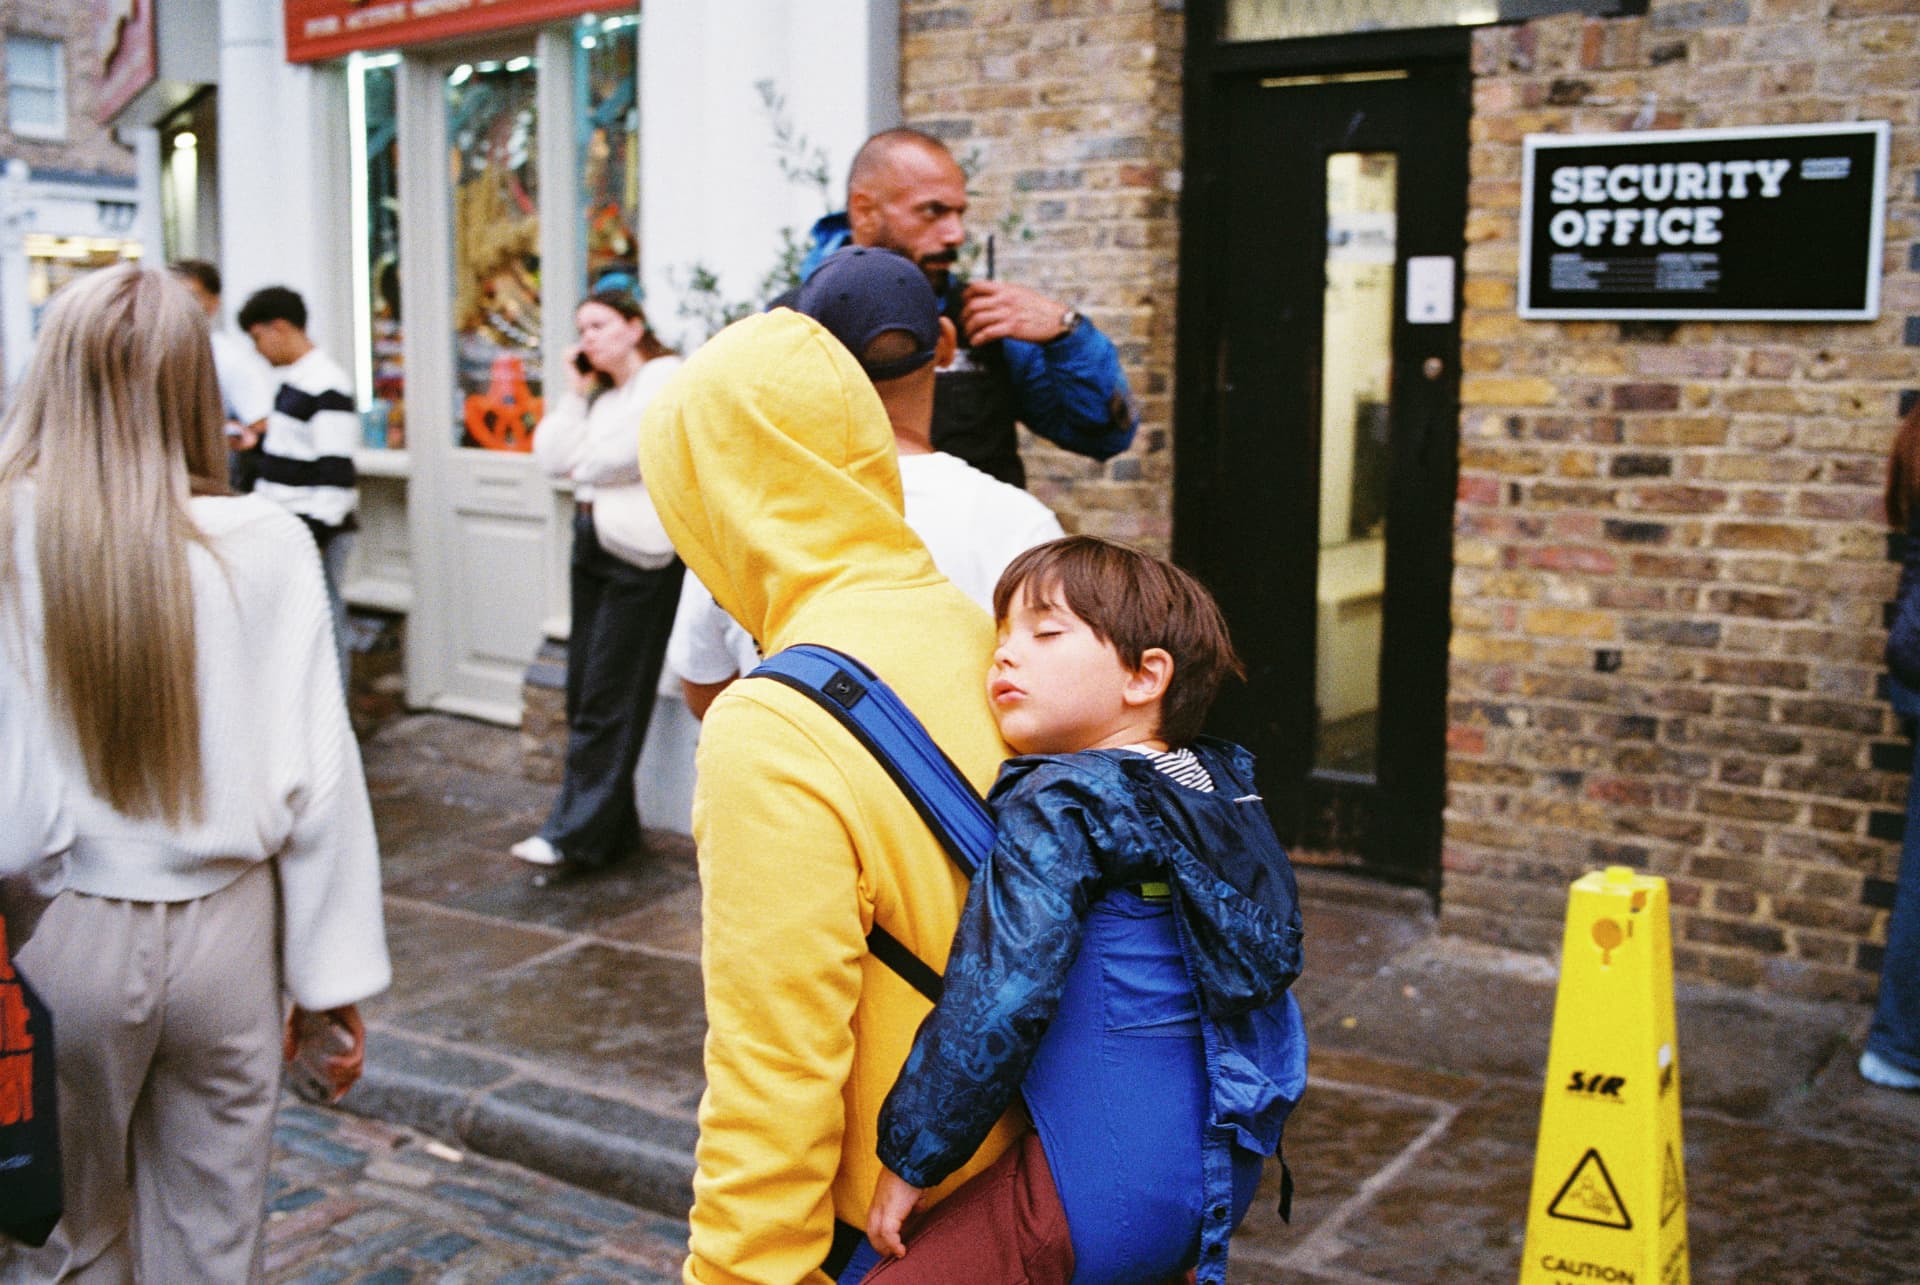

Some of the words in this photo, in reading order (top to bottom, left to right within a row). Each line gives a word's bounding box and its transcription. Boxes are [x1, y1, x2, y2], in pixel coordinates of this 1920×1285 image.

[1551, 159, 1790, 204] SECURITY
[1550, 207, 1723, 247] OFFICE
[1540, 1255, 1635, 1284] CAUTION
